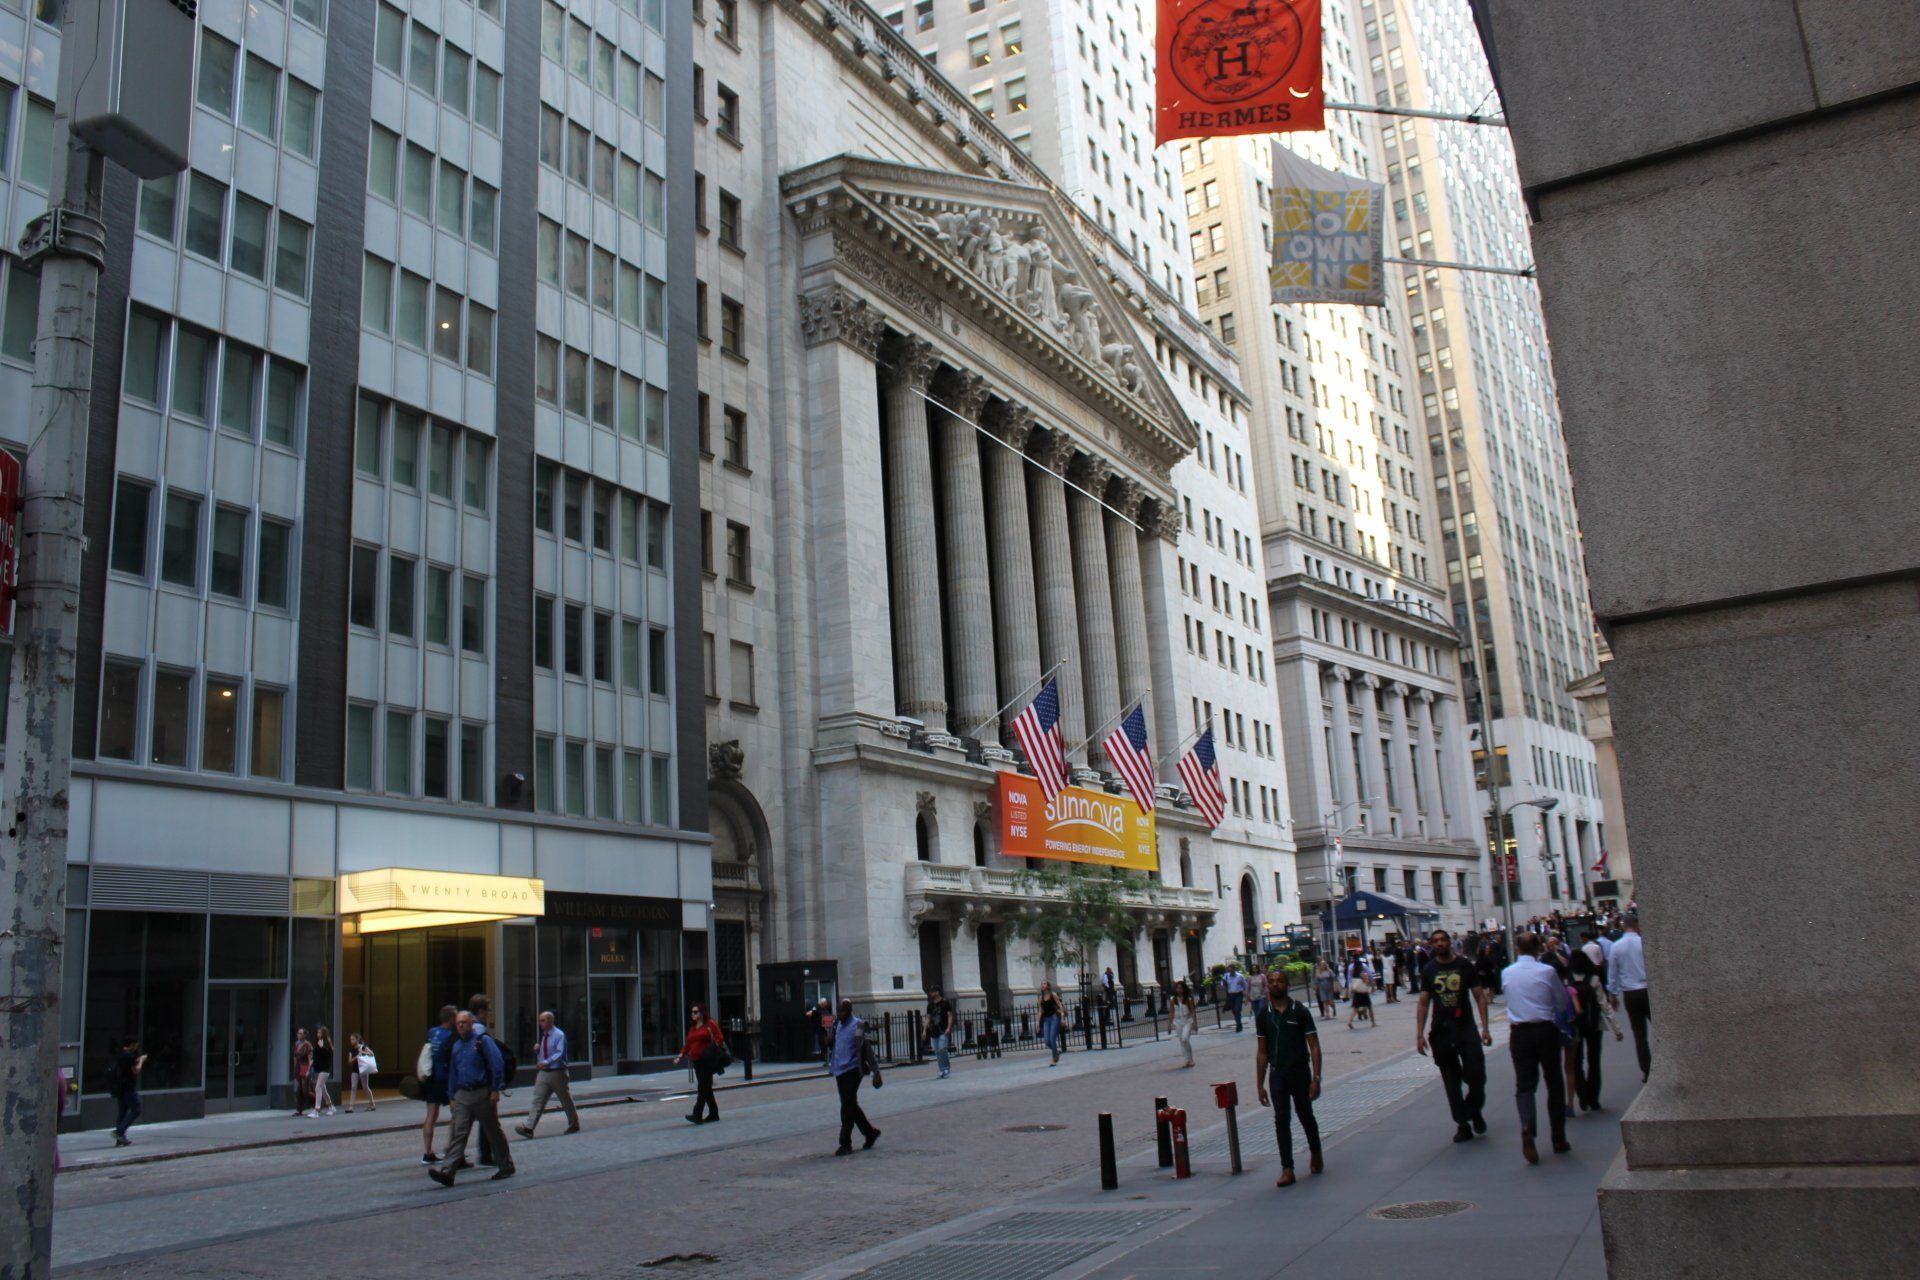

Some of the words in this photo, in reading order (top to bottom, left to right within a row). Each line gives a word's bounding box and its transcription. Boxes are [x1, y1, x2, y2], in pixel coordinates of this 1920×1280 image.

[1214, 41, 1252, 80] H
[1178, 102, 1292, 130] HERMES
[1009, 791, 1027, 805] NOVA
[1010, 825, 1028, 838] NYSE
[1045, 839, 1072, 852] POWERING
[1072, 842, 1091, 854] ENERGY
[1091, 845, 1126, 860] INDEPENDENCE
[411, 884, 471, 898] TWENTY
[481, 889, 529, 901] BROAD
[554, 901, 606, 918] WILLIAM
